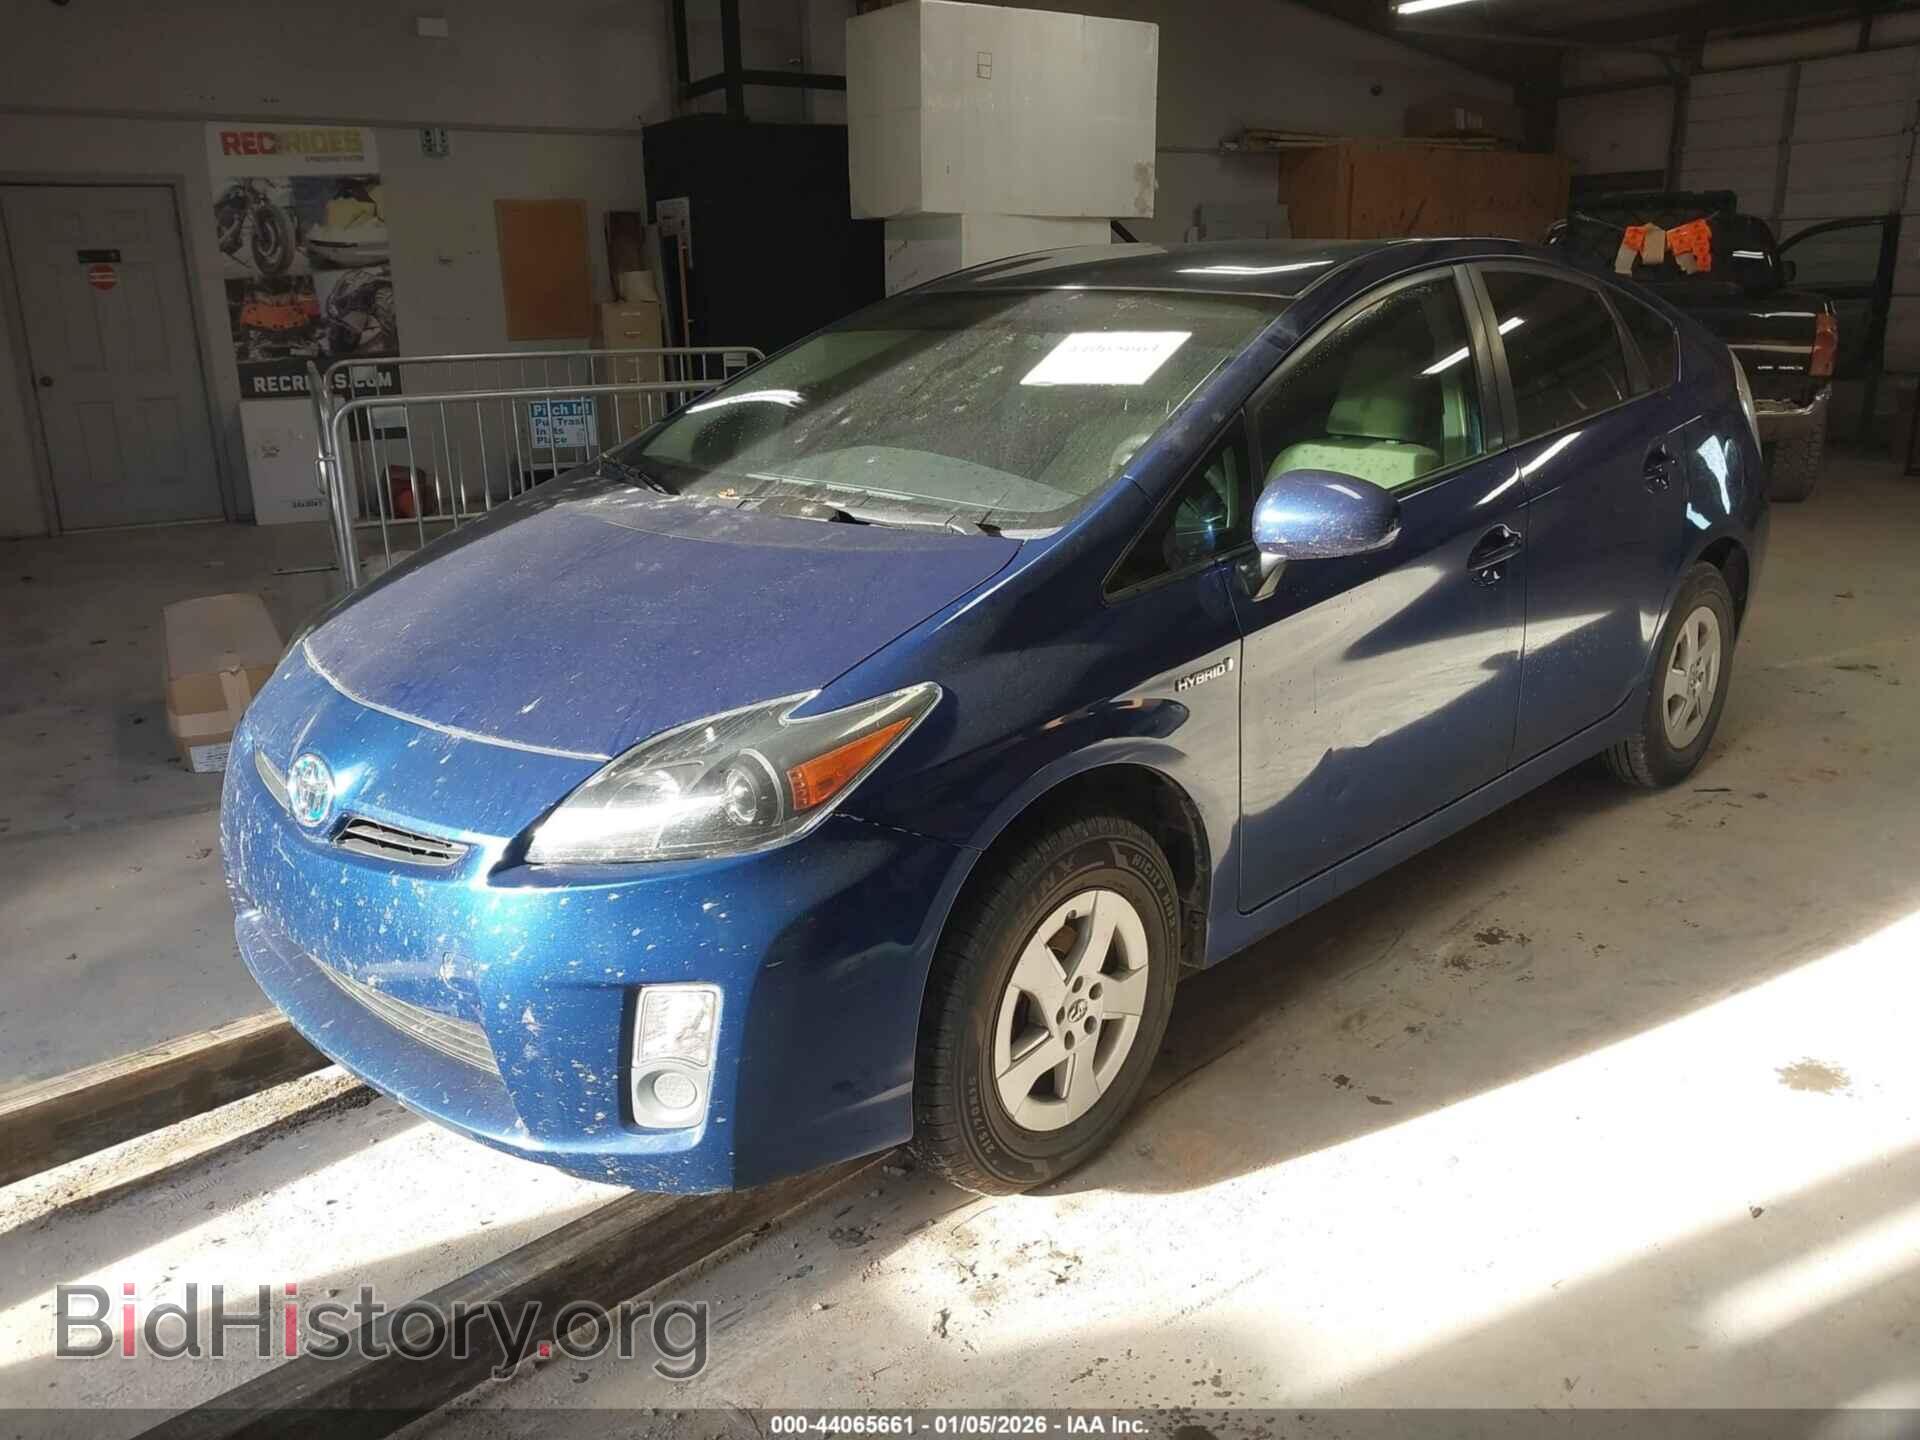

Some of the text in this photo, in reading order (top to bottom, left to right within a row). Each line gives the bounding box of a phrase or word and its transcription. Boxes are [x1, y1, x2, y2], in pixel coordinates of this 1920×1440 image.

[533, 403, 569, 416] Pich
[535, 418, 551, 427] Pu
[1176, 663, 1226, 692] HYBRID
